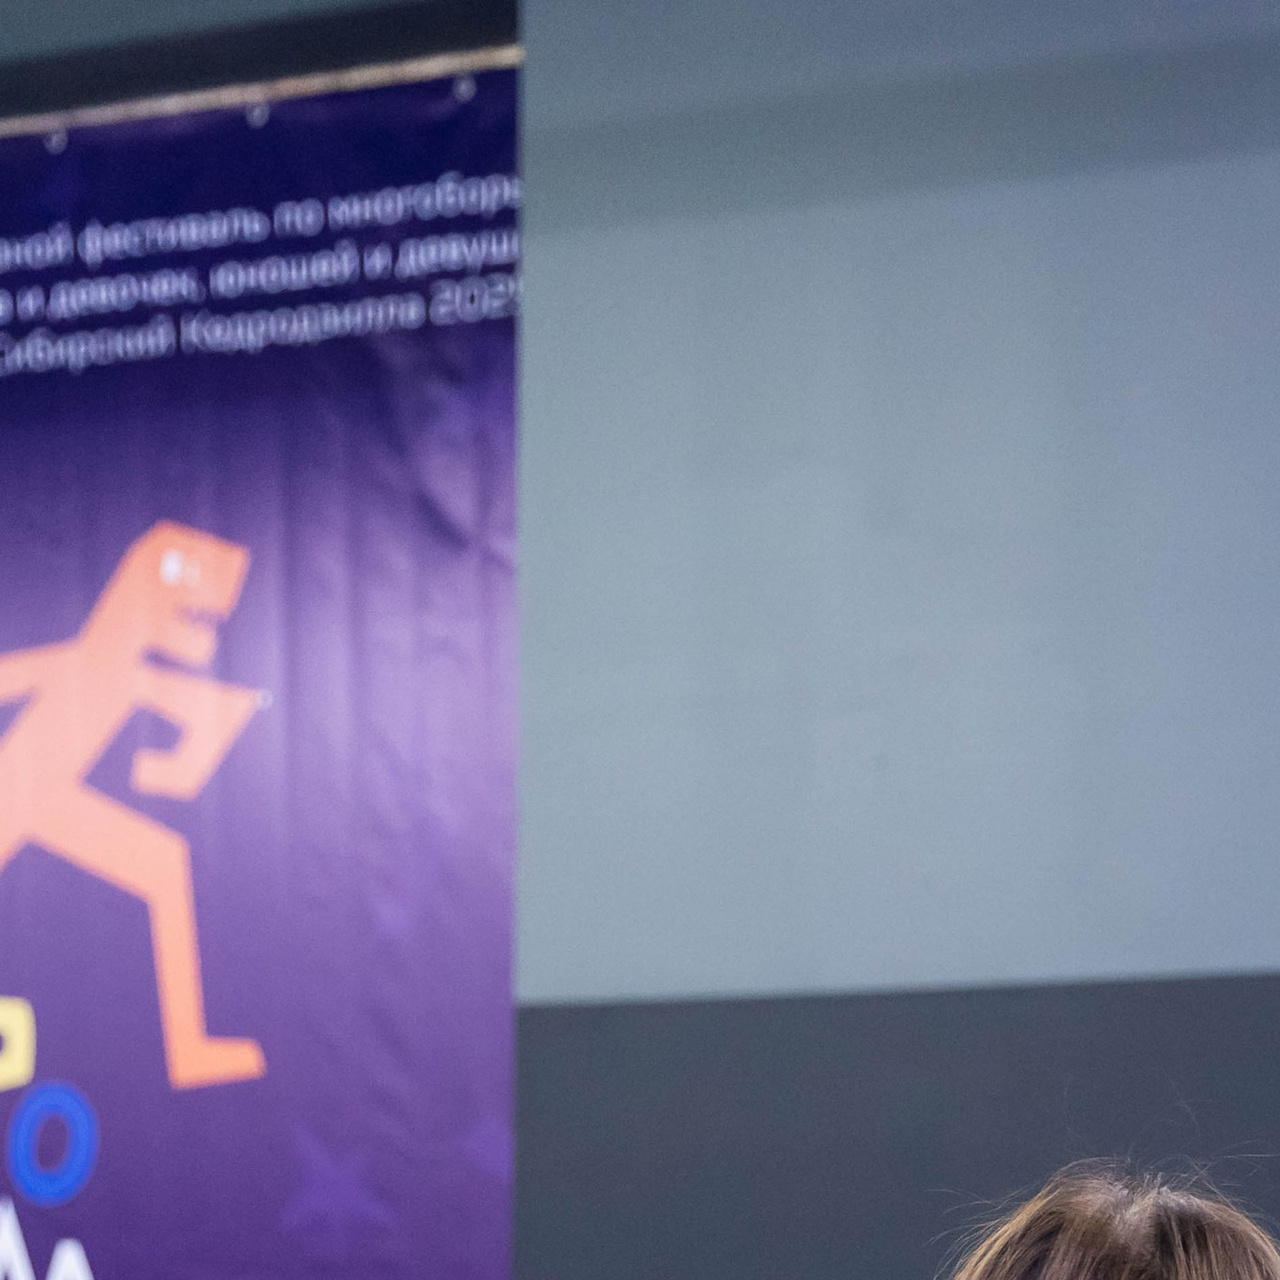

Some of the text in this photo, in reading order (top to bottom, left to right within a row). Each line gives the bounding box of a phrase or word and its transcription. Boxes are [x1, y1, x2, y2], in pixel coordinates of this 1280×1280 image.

[77, 207, 271, 270] фестиваль
[274, 198, 325, 238] по
[210, 238, 361, 298] юношей
[364, 243, 393, 280] и
